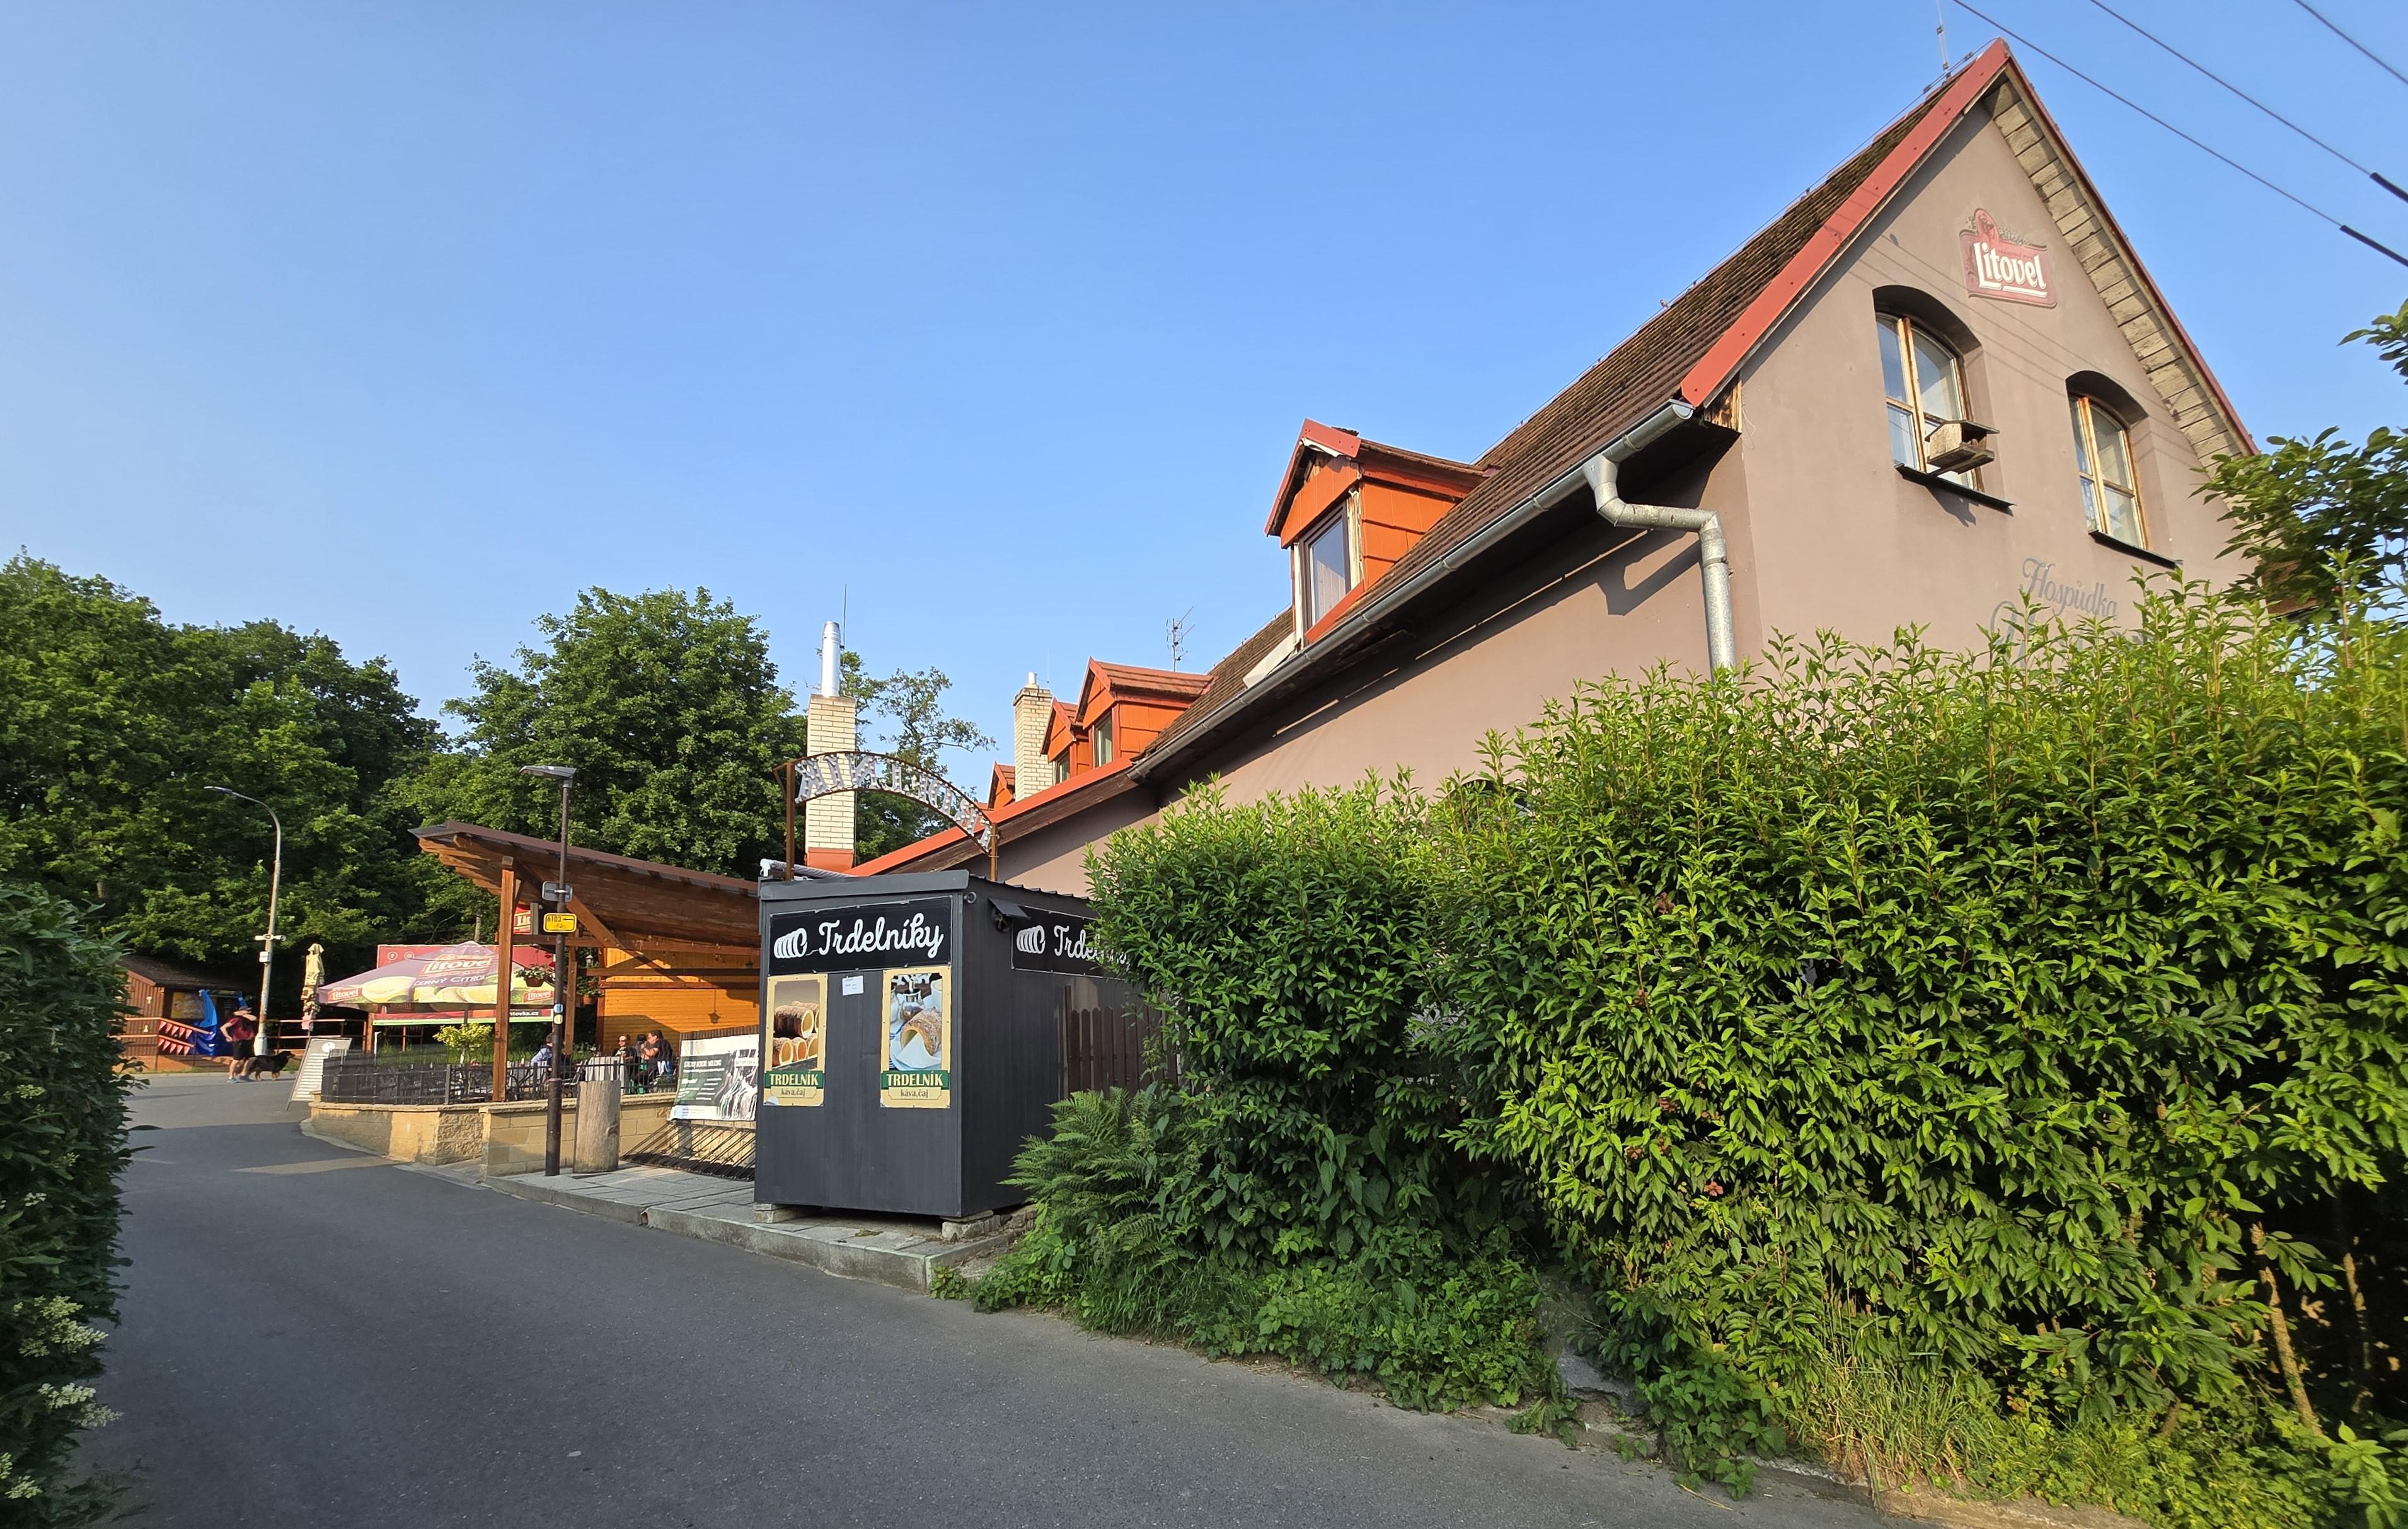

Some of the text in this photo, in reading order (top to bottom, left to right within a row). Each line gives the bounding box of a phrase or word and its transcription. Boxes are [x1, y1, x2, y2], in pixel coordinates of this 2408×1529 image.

[1973, 241, 2047, 290] Litovel
[819, 913, 944, 959] Trdelníky
[423, 958, 492, 974] Litovel
[332, 988, 359, 1000] Litovel
[769, 1071, 819, 1085] TRDELNÍK
[886, 1071, 943, 1086] TRDELNÍK
